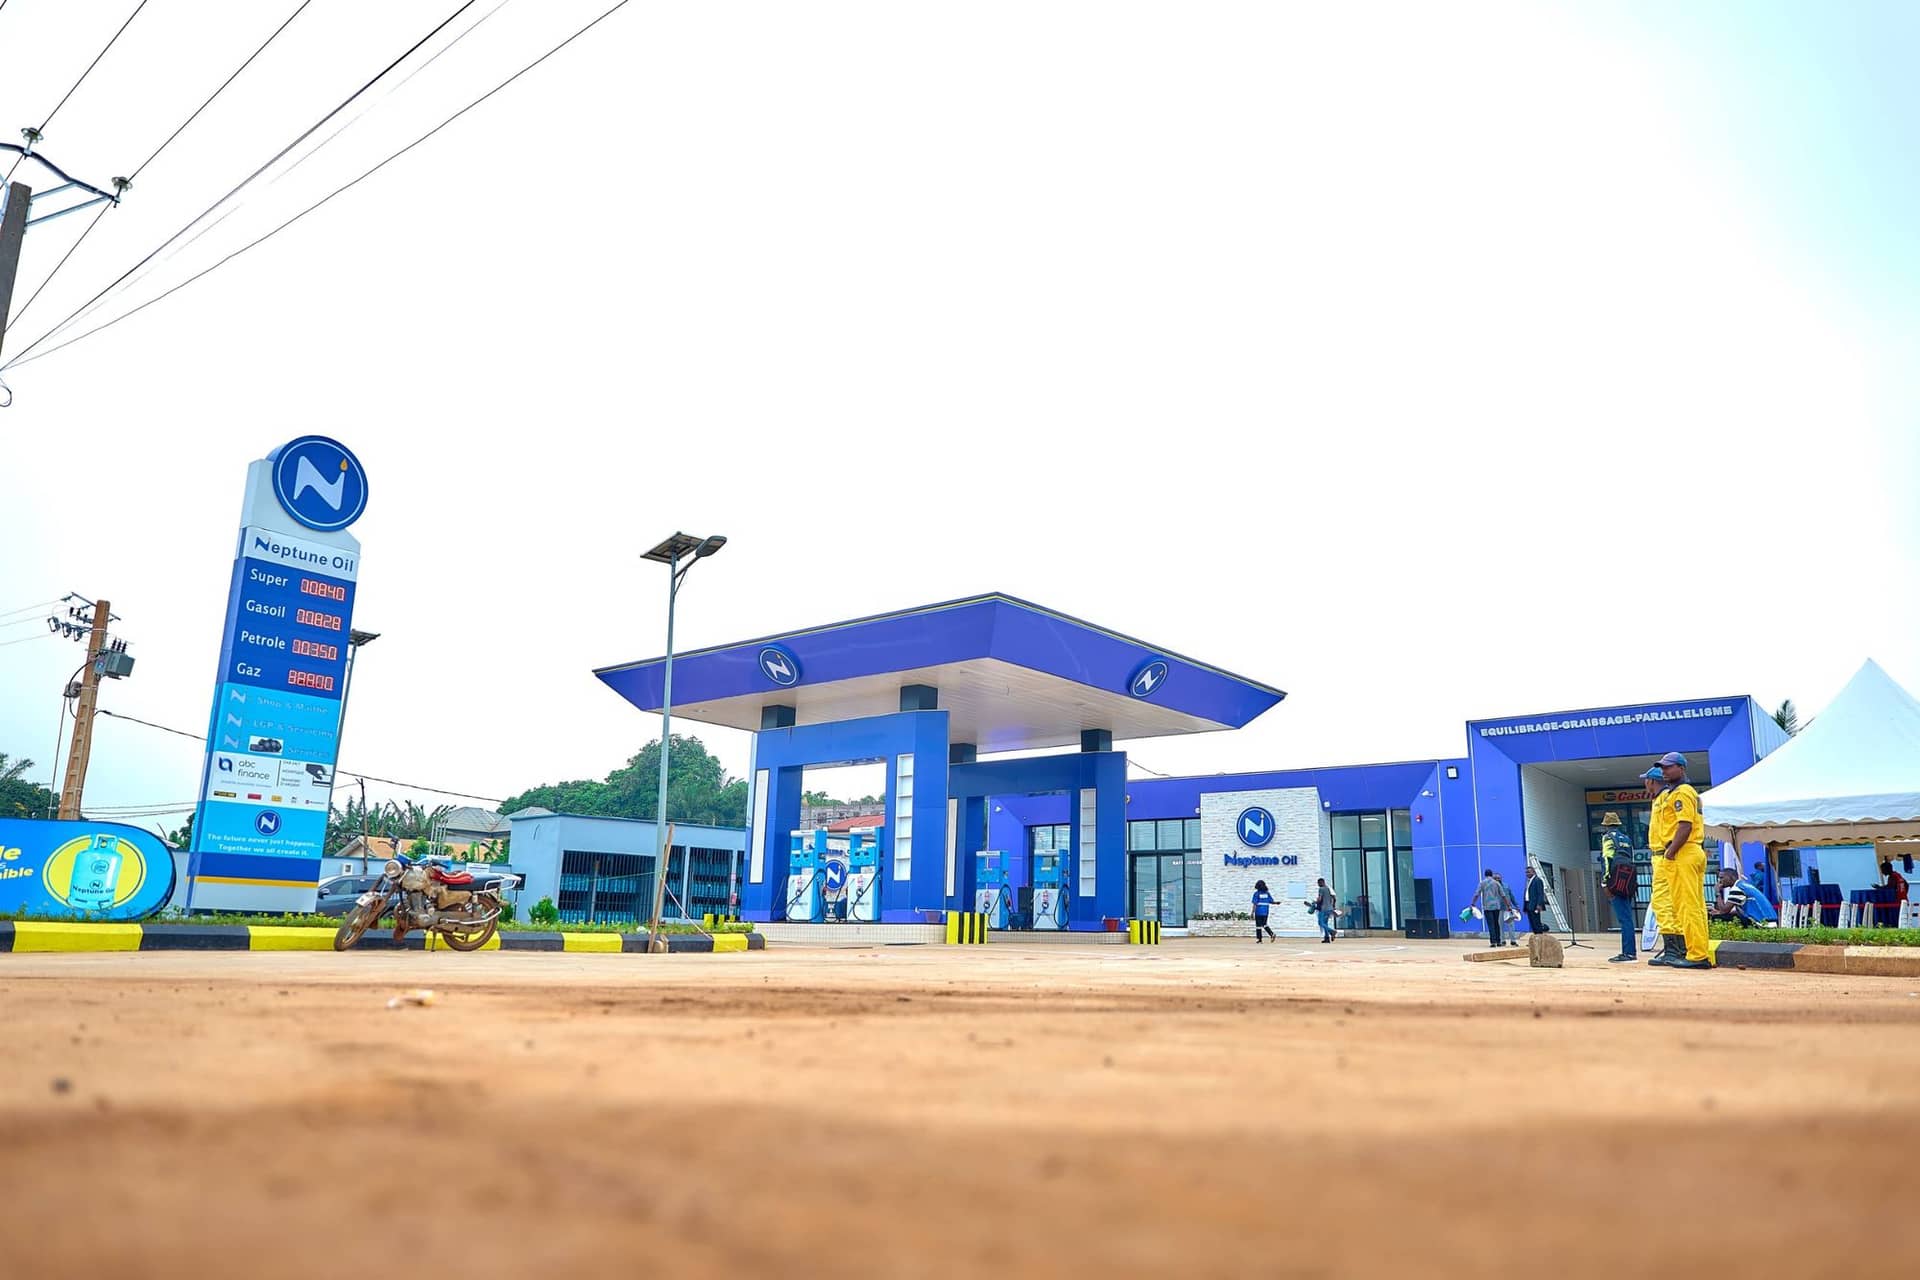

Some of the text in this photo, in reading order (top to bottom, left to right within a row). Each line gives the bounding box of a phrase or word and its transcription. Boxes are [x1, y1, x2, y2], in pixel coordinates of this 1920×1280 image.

[254, 536, 354, 572] Neptune Oil
[250, 568, 345, 601] Super 00840
[246, 599, 341, 631] Gasoil 00828
[240, 630, 286, 650] Petrole
[236, 662, 262, 677] Gaz
[239, 760, 255, 769] abc
[238, 768, 270, 780] finance
[1618, 790, 1655, 801] Castr
[223, 835, 246, 843] future
[218, 844, 251, 853] Together
[1224, 851, 1298, 868] Neptune Oil
